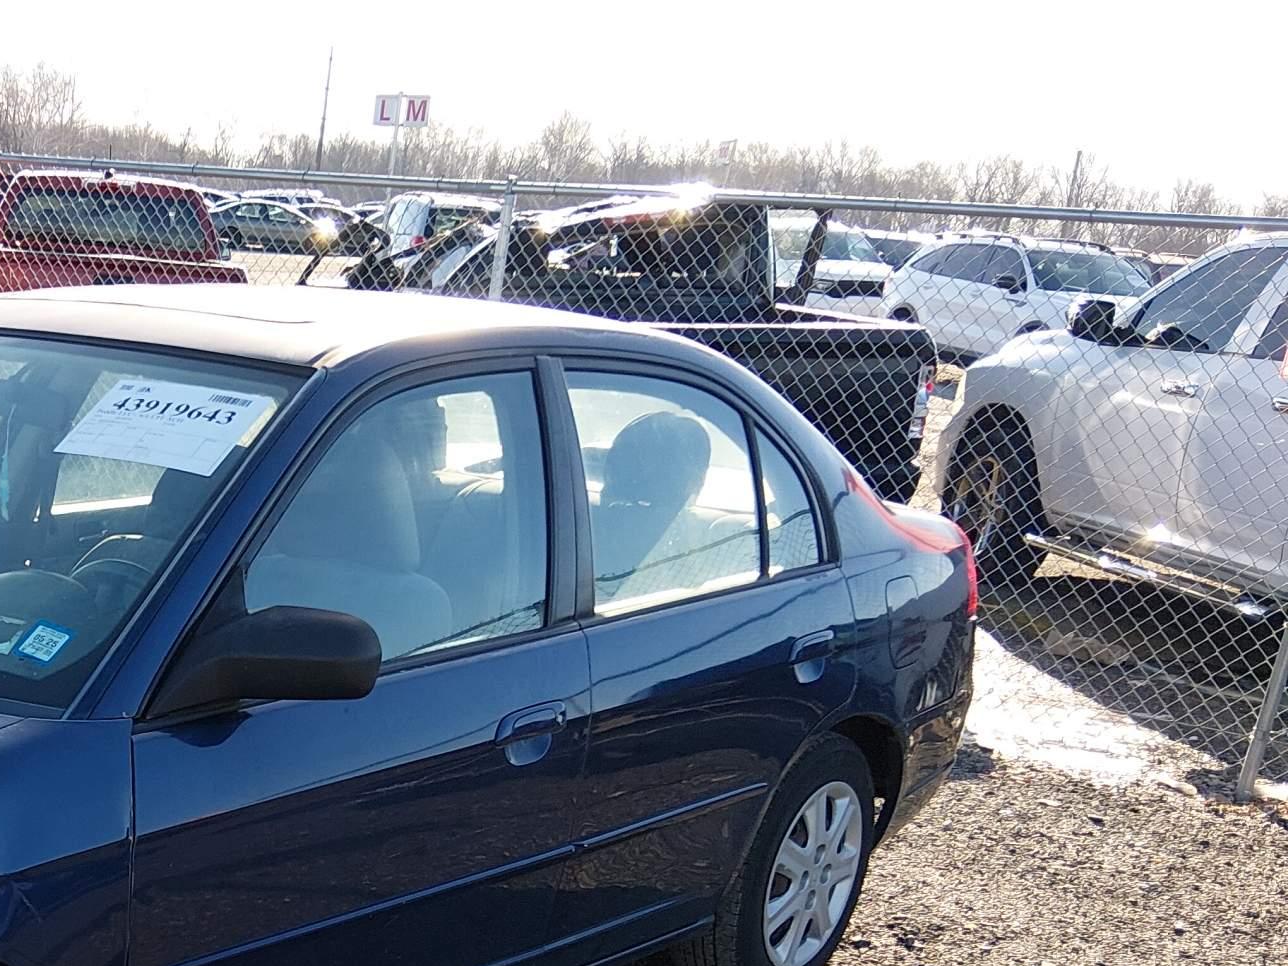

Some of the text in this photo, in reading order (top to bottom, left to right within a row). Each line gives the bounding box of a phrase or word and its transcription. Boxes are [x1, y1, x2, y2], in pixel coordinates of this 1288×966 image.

[379, 99, 428, 122] L M
[112, 396, 237, 425] 43919643
